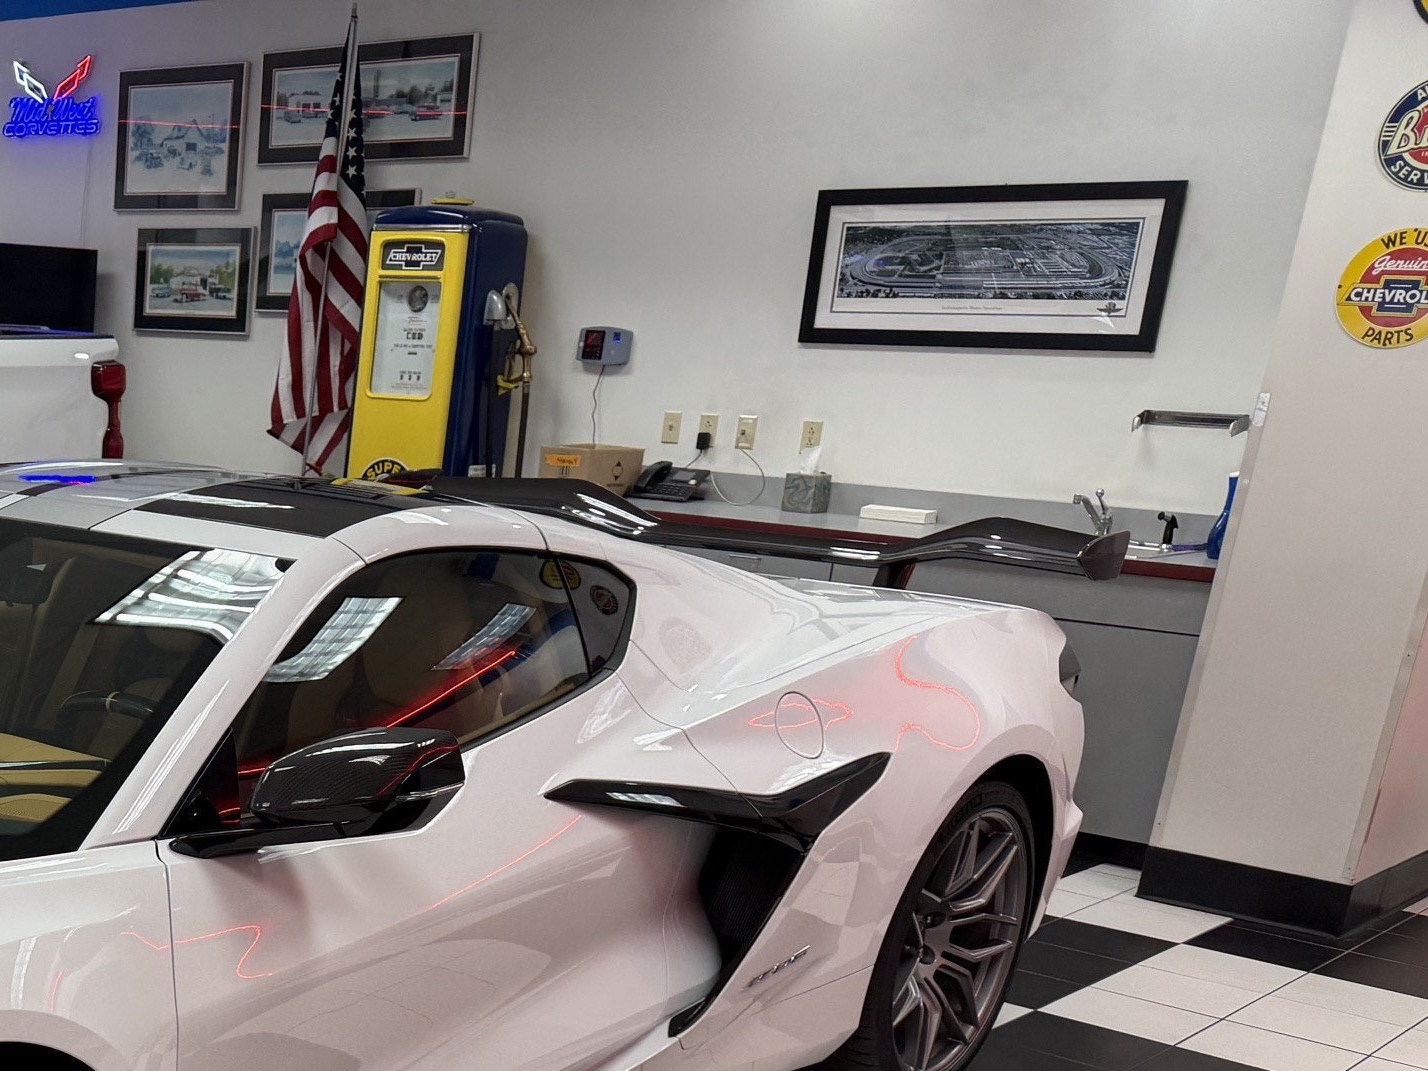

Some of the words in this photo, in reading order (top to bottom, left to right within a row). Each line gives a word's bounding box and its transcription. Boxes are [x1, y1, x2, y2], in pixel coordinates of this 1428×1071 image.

[3, 120, 99, 136] CORVETTES
[1385, 109, 1428, 157] Bu
[1380, 231, 1408, 250] WE
[391, 253, 439, 262] CHEVROLET
[1361, 326, 1414, 347] PARTS
[366, 461, 402, 480] SUPE
